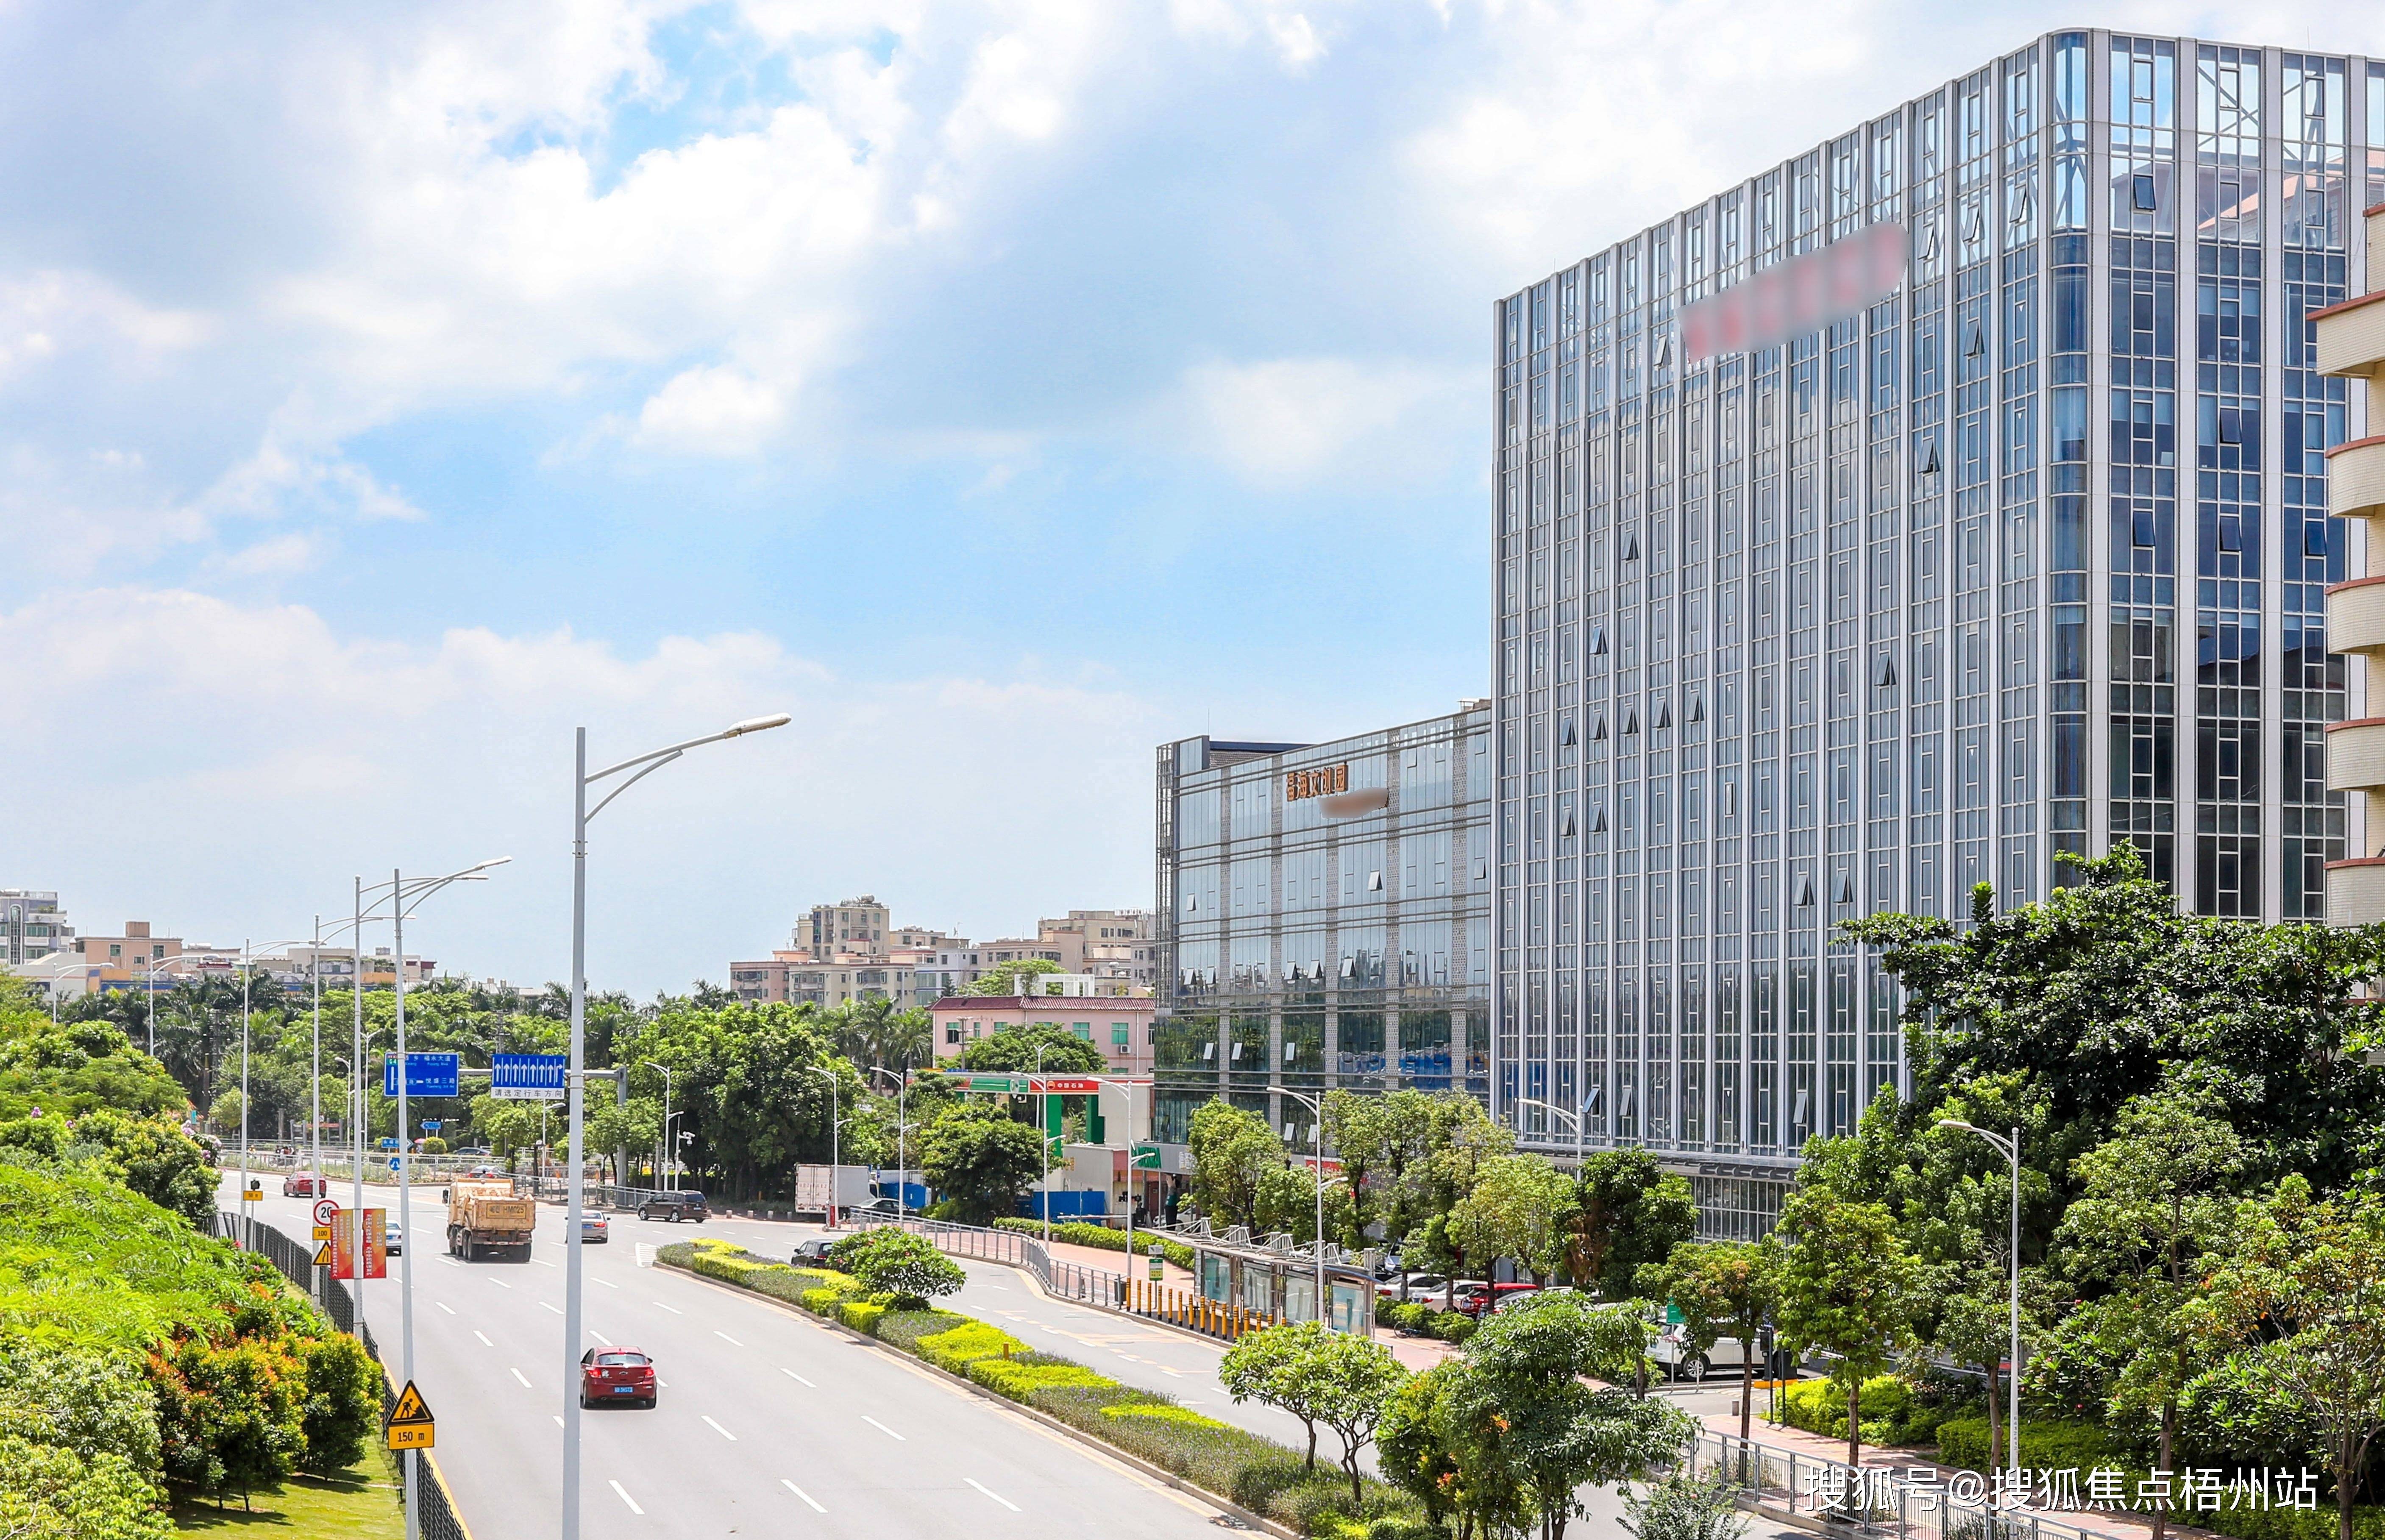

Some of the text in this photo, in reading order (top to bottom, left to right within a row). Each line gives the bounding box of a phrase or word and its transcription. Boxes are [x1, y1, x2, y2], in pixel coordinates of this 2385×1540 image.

[495, 1090, 562, 1098] 请选定行车方向
[398, 1431, 424, 1442] 150 m
